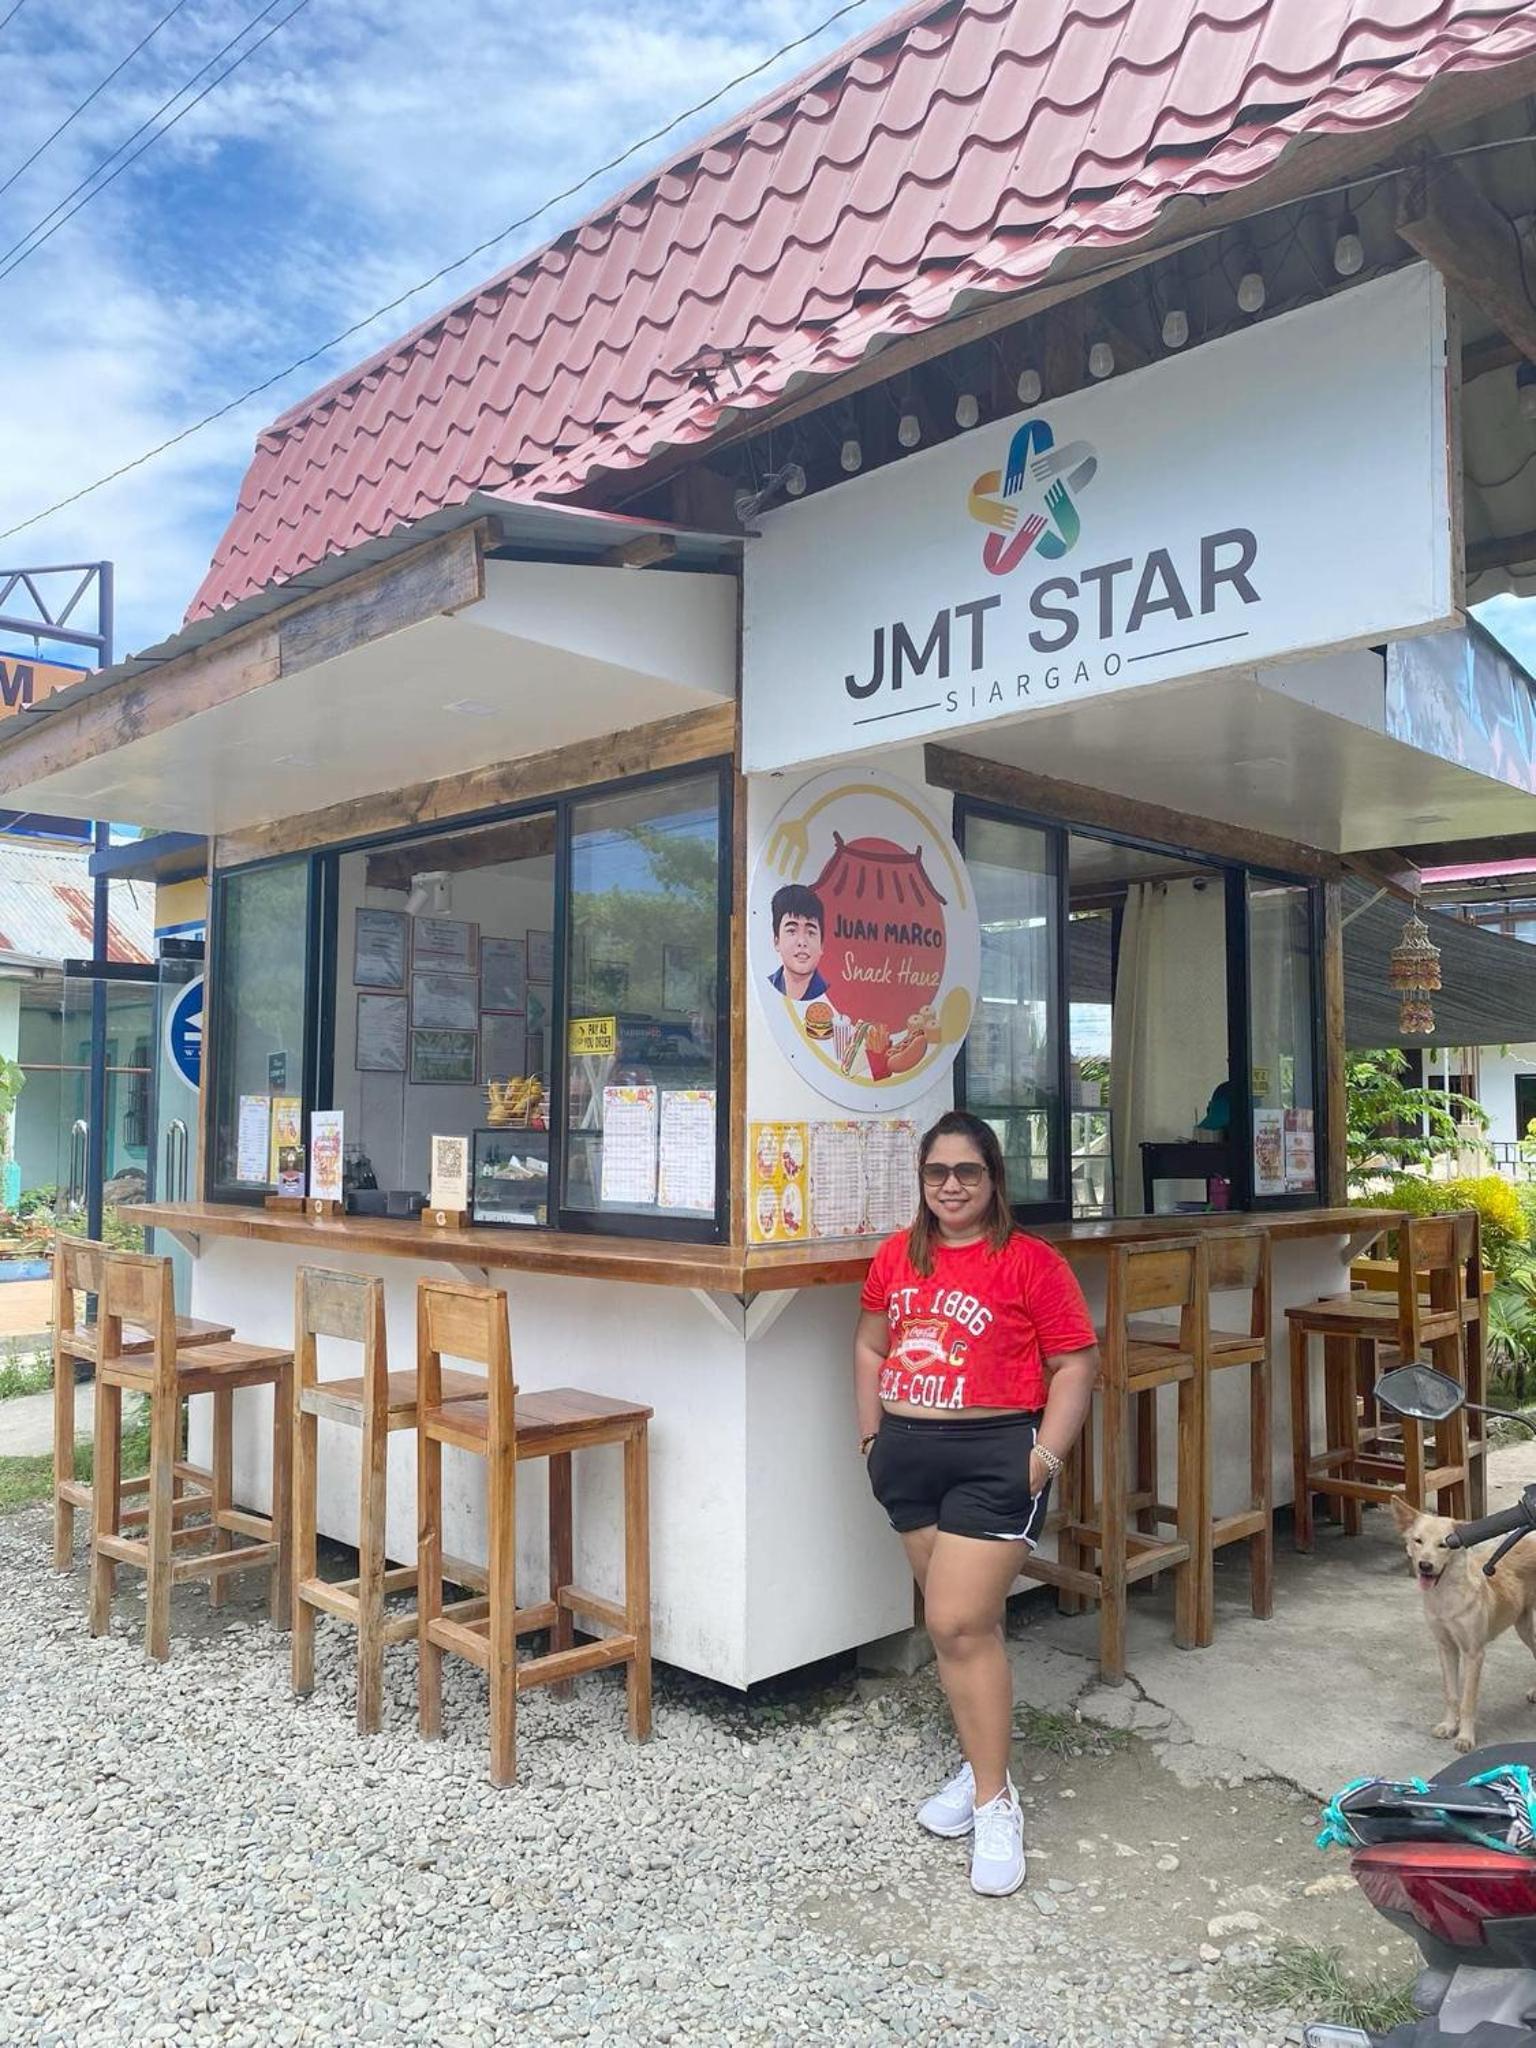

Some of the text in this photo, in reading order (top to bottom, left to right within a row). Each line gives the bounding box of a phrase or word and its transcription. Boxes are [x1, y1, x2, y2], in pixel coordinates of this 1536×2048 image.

[845, 527, 1262, 700] JMT STAR
[945, 652, 1122, 713] SIARGAO
[833, 913, 878, 941] JUAN
[841, 950, 893, 984] Snack
[887, 1287, 994, 1337] ST. 1886
